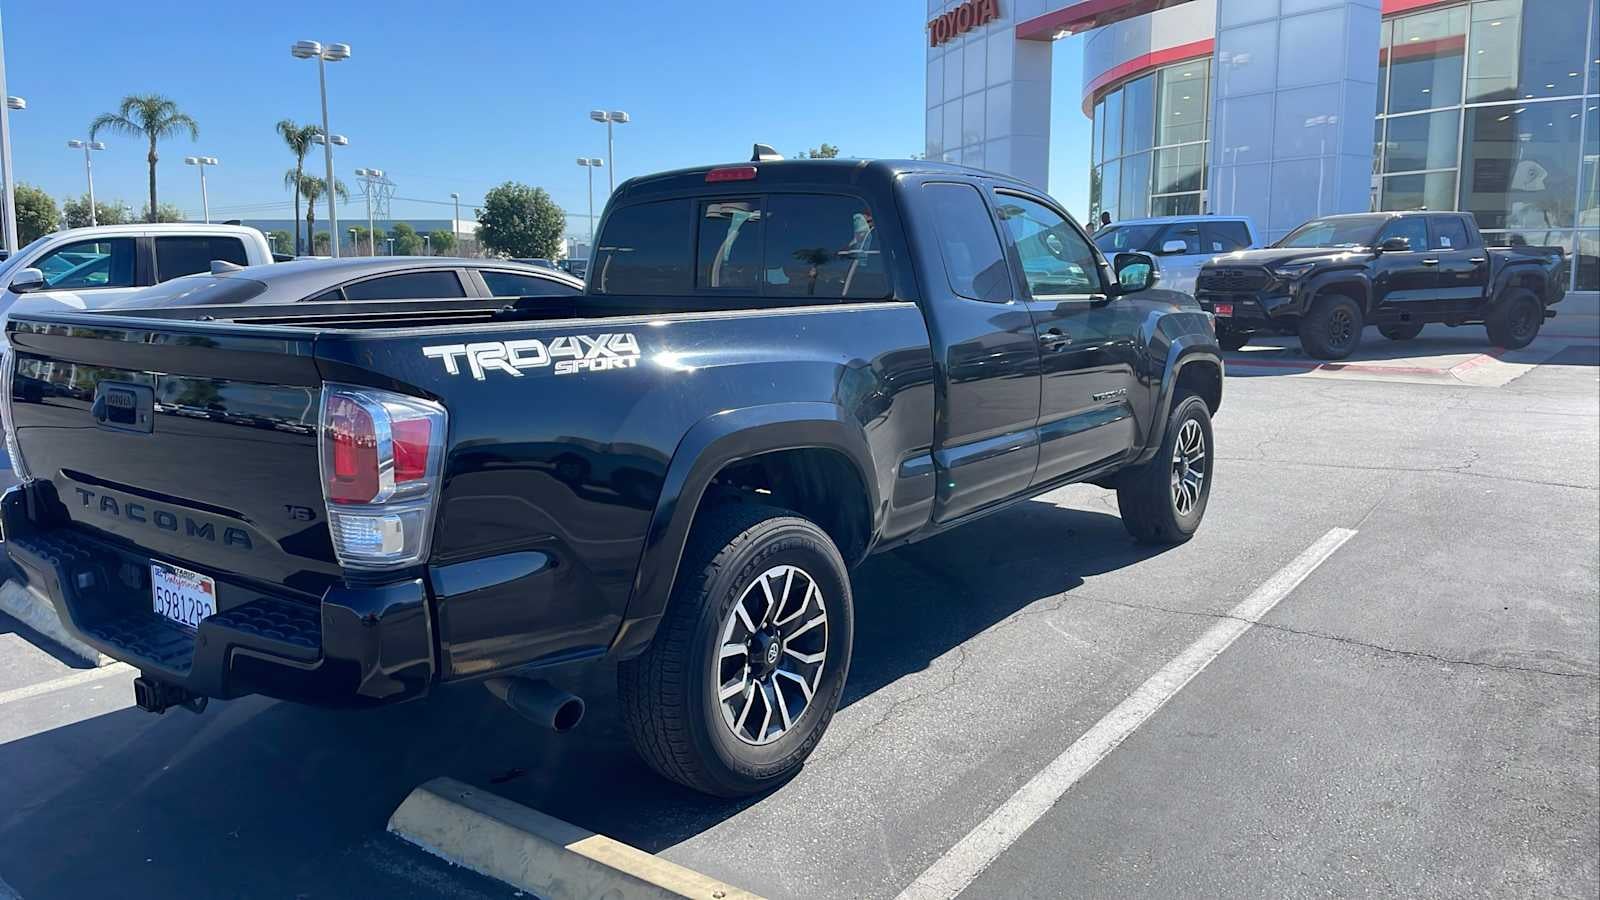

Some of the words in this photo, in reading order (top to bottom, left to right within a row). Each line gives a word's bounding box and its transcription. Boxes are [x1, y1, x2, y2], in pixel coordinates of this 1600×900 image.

[927, 0, 999, 48] TOYOTA
[422, 339, 551, 381] TRD
[554, 354, 641, 375] SPORT
[75, 487, 253, 550] TACOMA
